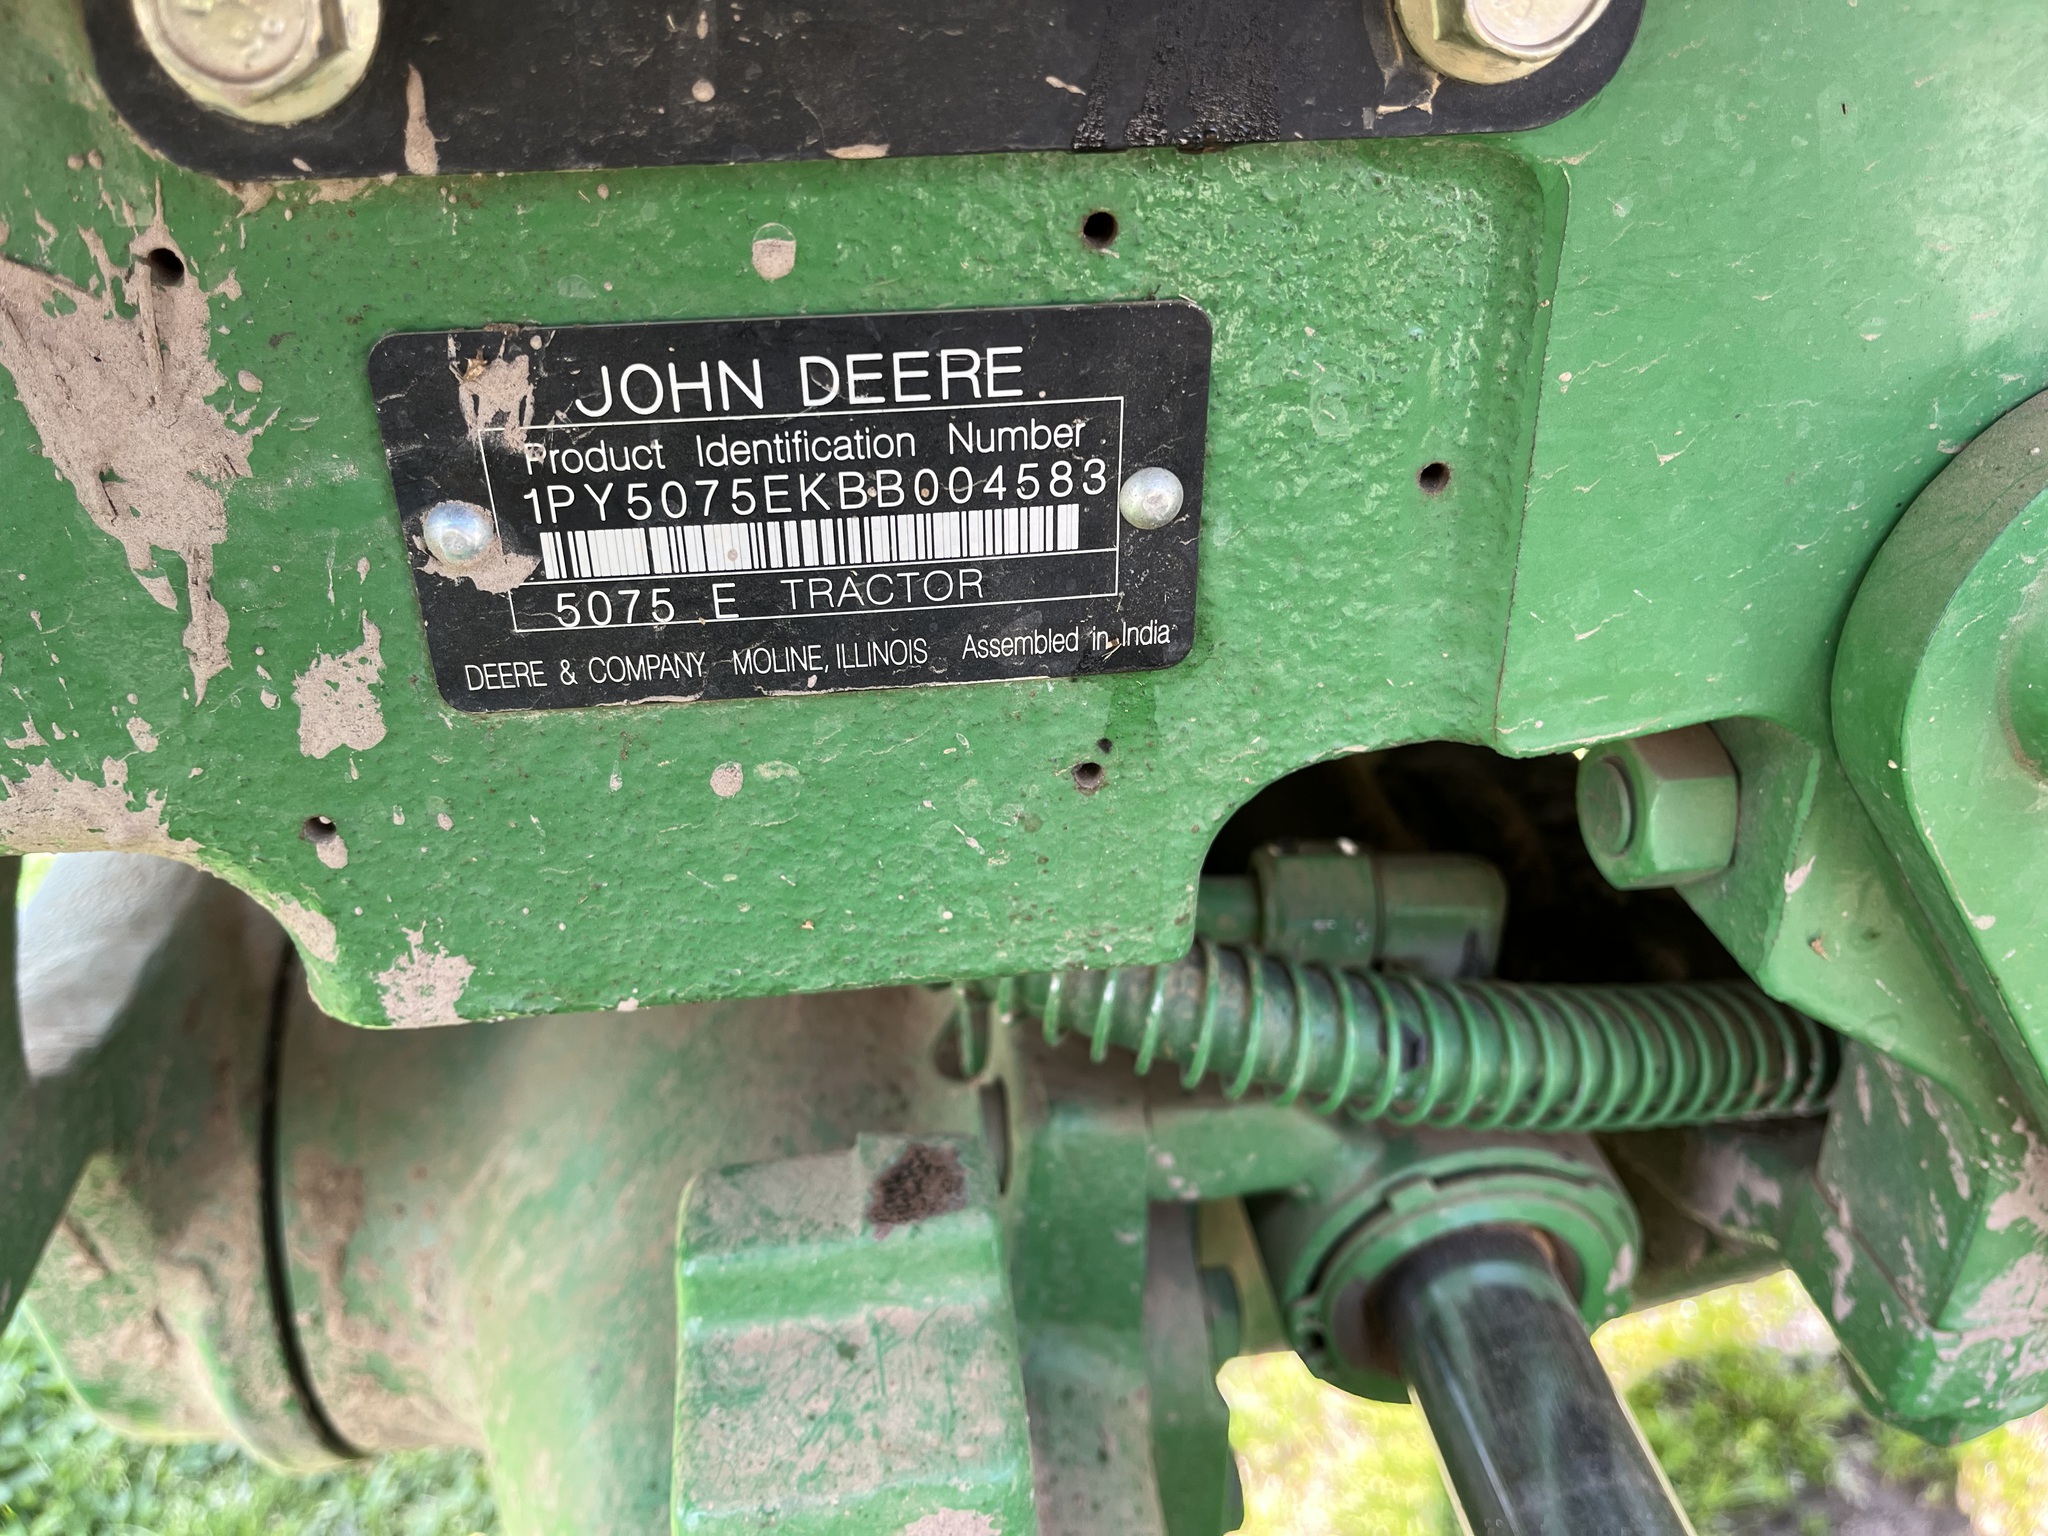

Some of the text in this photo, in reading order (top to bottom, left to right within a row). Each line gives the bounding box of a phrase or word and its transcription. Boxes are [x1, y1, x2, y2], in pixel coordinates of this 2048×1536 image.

[575, 345, 1024, 418] JOHN DEERE
[524, 418, 1086, 475] Product Identification Number
[523, 457, 1107, 525] 1PY5075EKBB004583
[556, 568, 984, 628] 5075 E TRACTOR
[464, 619, 1171, 691] DEERE & COMPANY MOLINE, ILLINOIS Assembled in India
